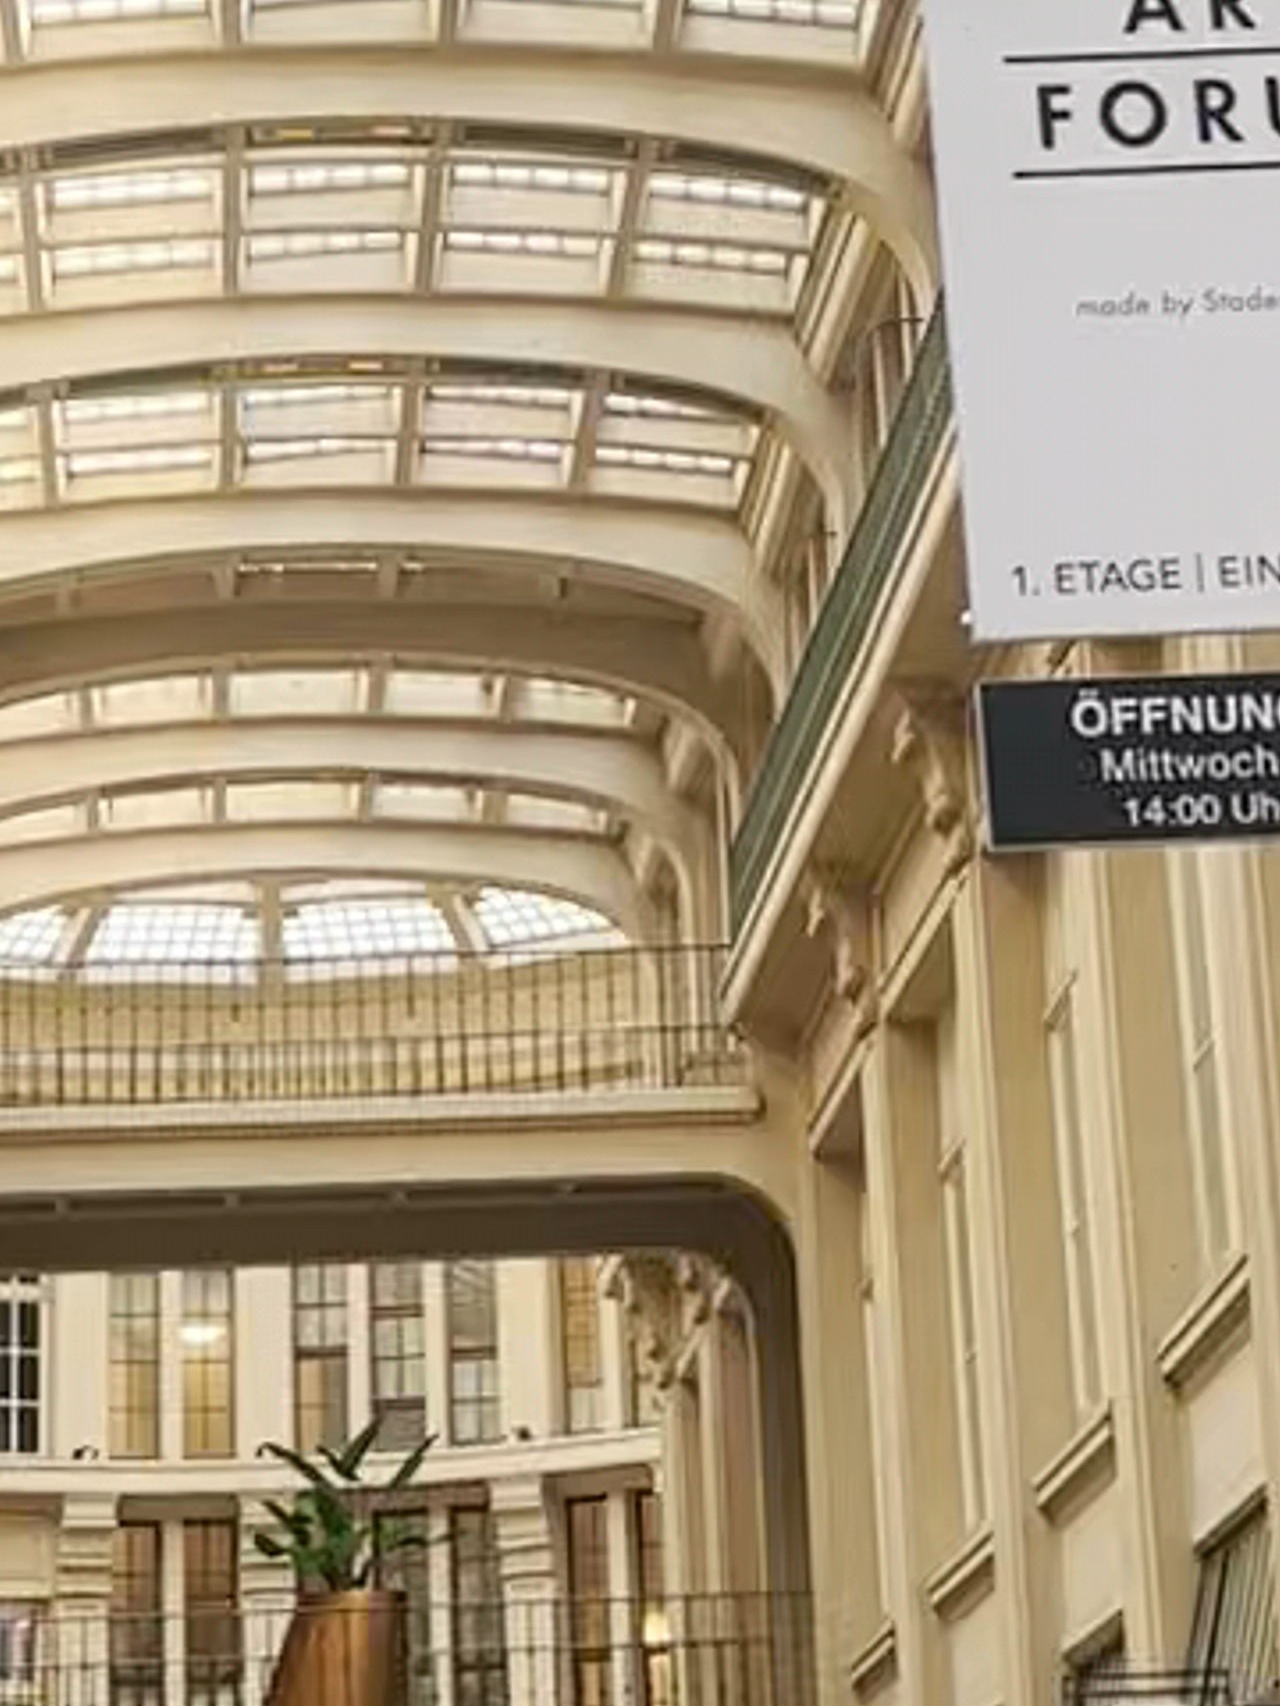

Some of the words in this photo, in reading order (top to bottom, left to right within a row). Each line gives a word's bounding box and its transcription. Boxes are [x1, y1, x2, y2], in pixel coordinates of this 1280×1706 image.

[1075, 291, 1151, 317] made
[1162, 287, 1194, 324] by
[1013, 566, 1038, 595] 1.
[1055, 559, 1181, 593] ETAGE
[1101, 745, 1279, 781] Mittwoch
[1126, 794, 1221, 826] 14:00
